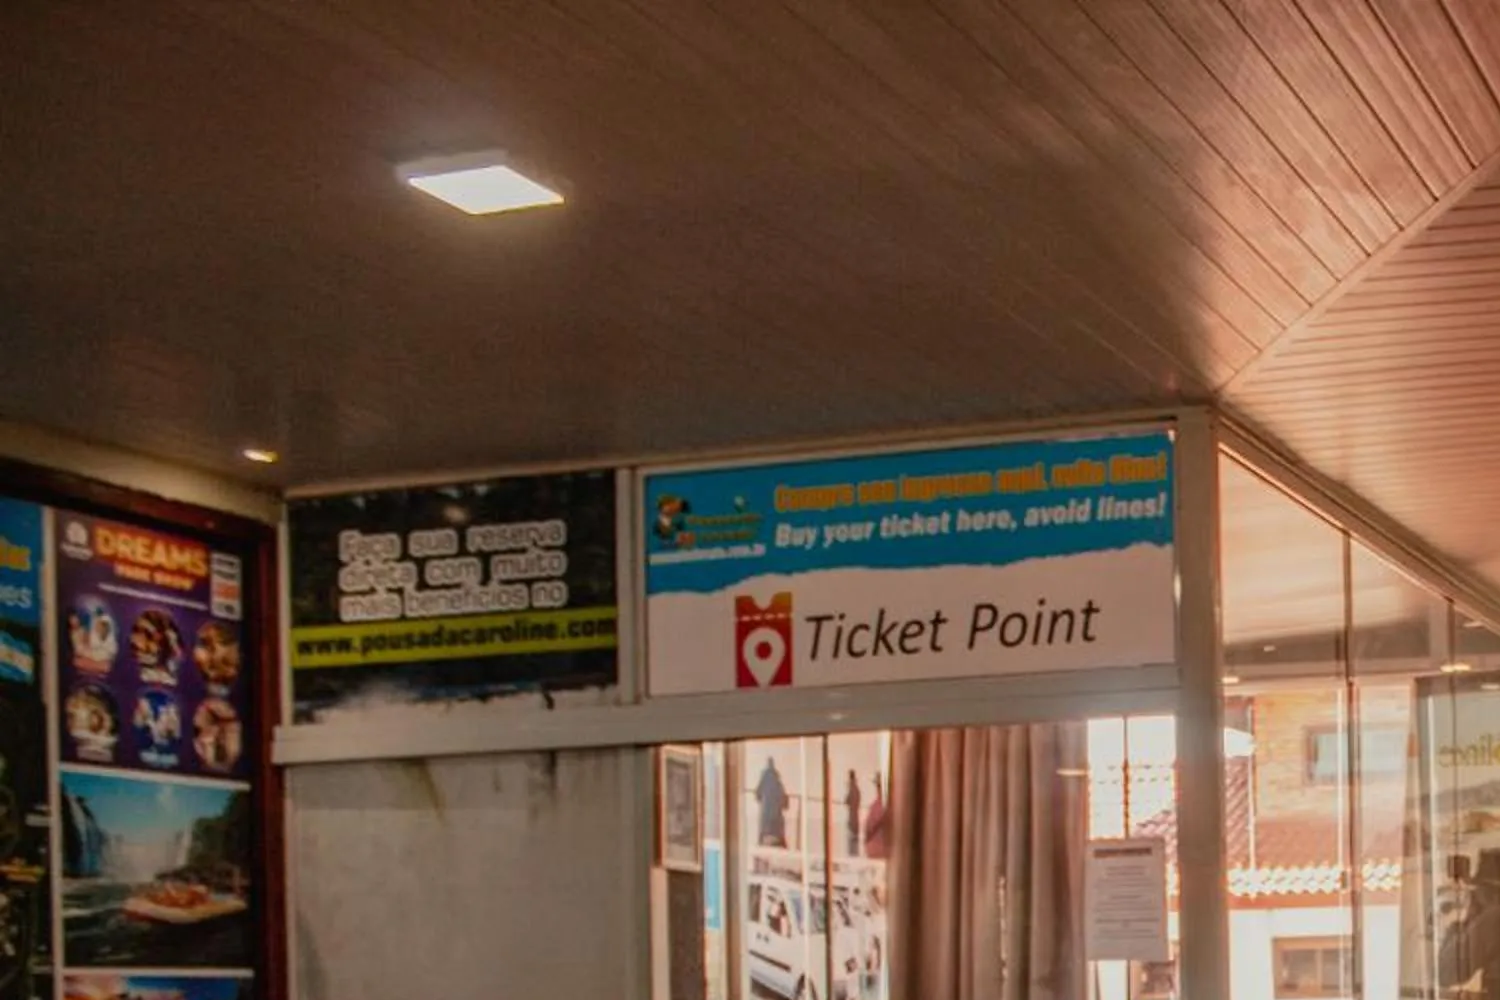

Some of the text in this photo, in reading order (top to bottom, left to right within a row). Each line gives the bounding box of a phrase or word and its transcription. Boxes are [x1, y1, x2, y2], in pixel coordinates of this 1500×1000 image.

[408, 529, 458, 557] sua
[466, 519, 567, 552] reserva
[775, 523, 817, 550] Buy
[823, 520, 875, 549] your
[880, 511, 950, 539] ticket
[956, 507, 1017, 533] here,
[1023, 498, 1091, 527] avoid
[1097, 491, 1167, 521] lines!
[95, 528, 208, 578] DREAMS
[424, 556, 482, 585] com
[490, 550, 567, 581] muito
[339, 592, 401, 622] mais
[530, 581, 568, 608] no
[297, 617, 616, 656] www.pousadacaroline.com
[804, 598, 1101, 662] Ticket Point
